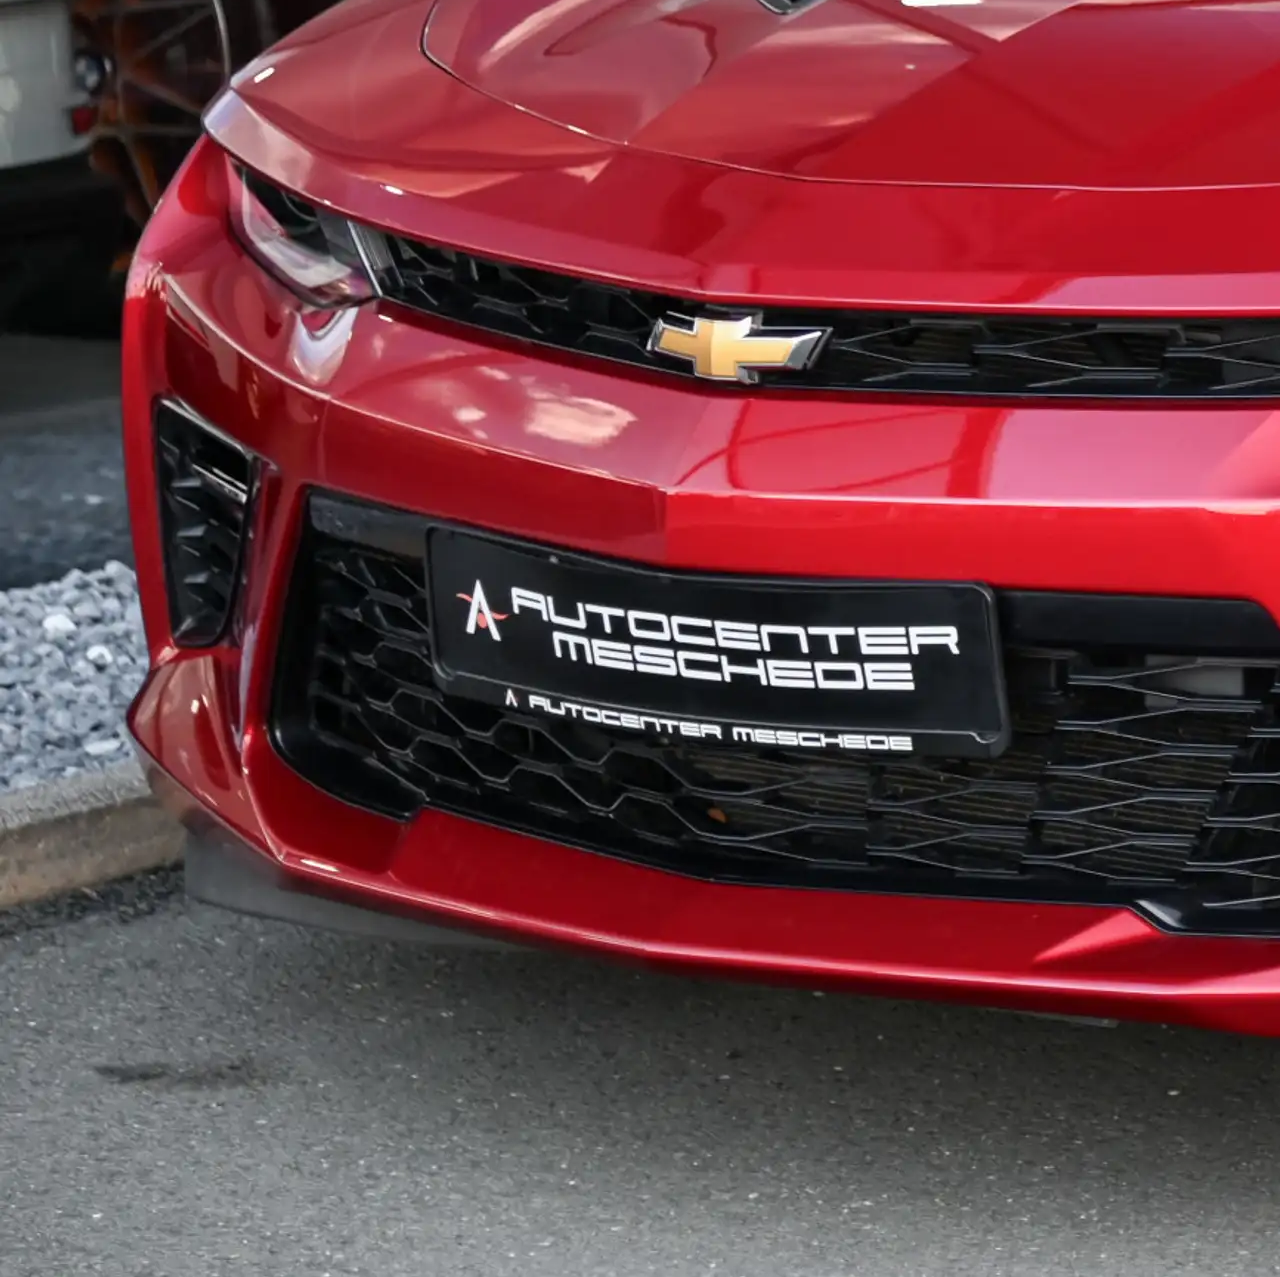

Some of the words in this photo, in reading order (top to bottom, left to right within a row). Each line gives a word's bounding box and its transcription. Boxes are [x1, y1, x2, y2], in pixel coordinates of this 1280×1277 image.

[510, 586, 960, 655] AUTOCENTER
[552, 630, 916, 691] MESCHEDE
[528, 694, 722, 740] AUTOCENTER
[732, 726, 913, 751] MESCHEDE
